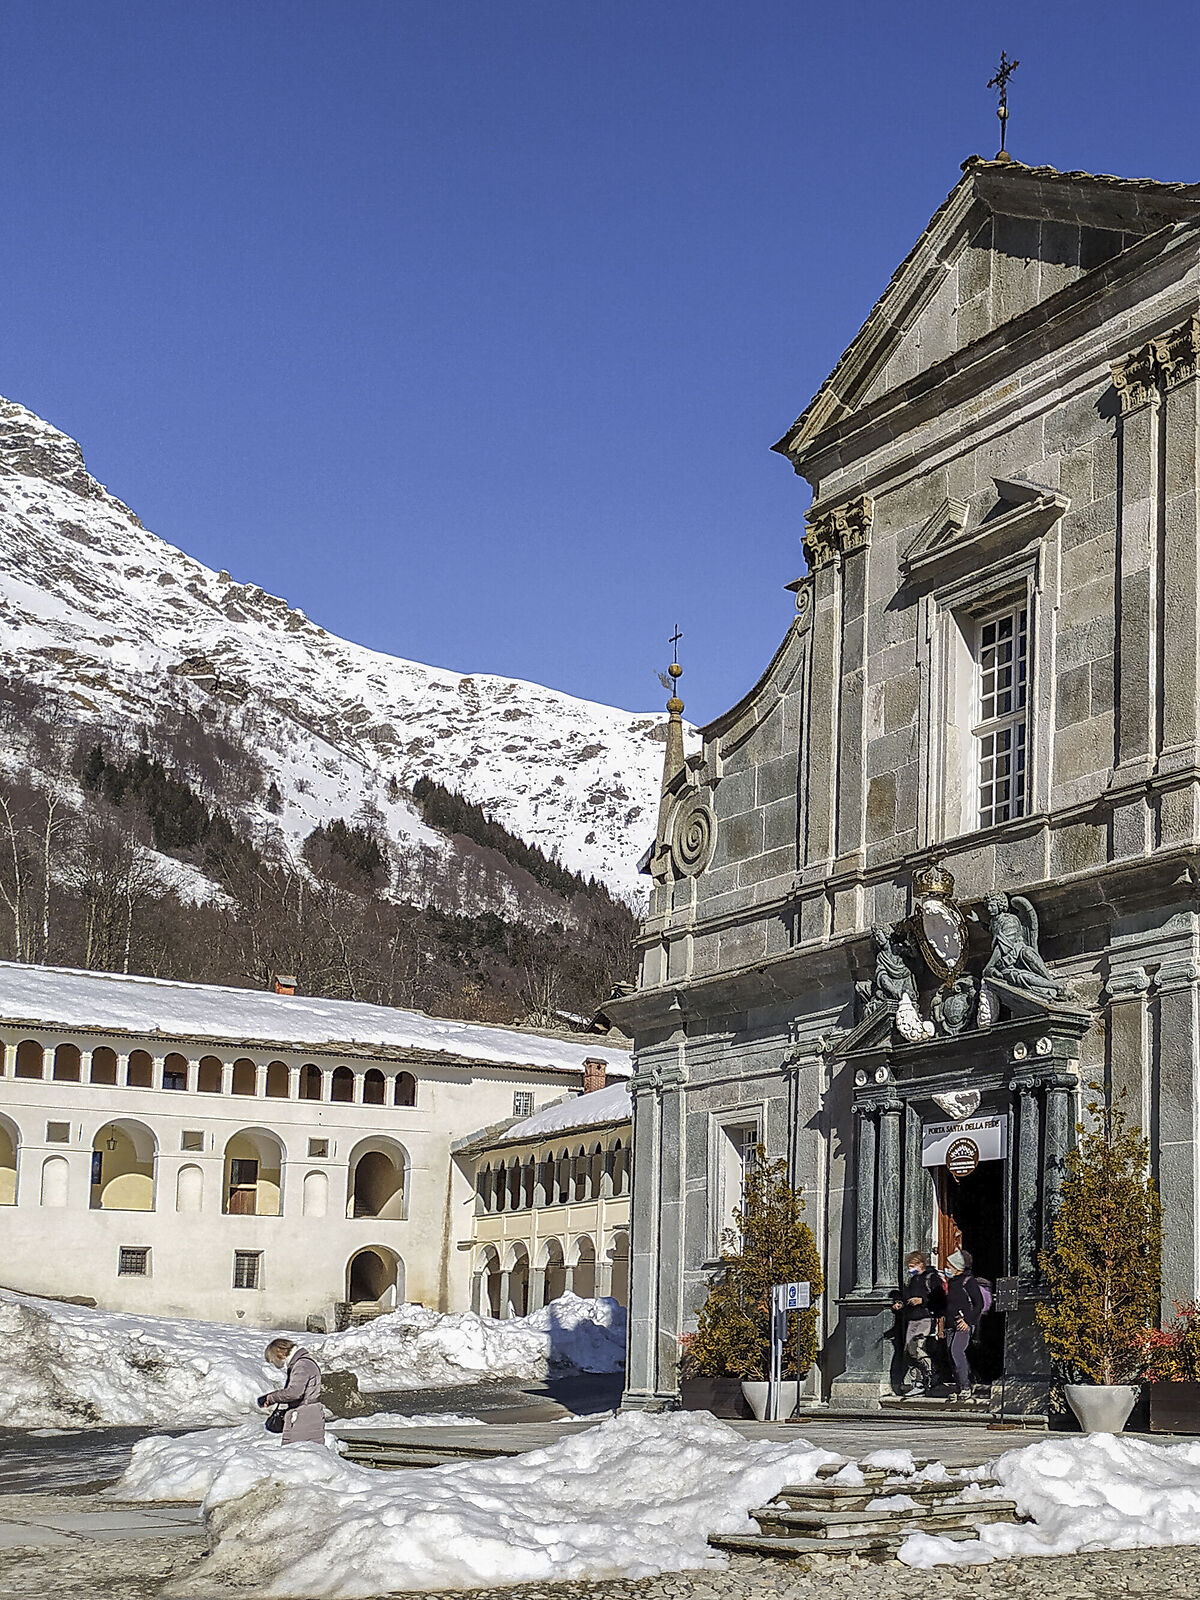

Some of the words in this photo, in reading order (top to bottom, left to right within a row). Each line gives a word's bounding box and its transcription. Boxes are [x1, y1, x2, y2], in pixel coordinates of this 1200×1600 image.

[928, 1127, 945, 1135] PORTA
[946, 1124, 964, 1133] SANTA
[965, 1122, 983, 1131] DELLA
[985, 1119, 1000, 1129] FEDE
